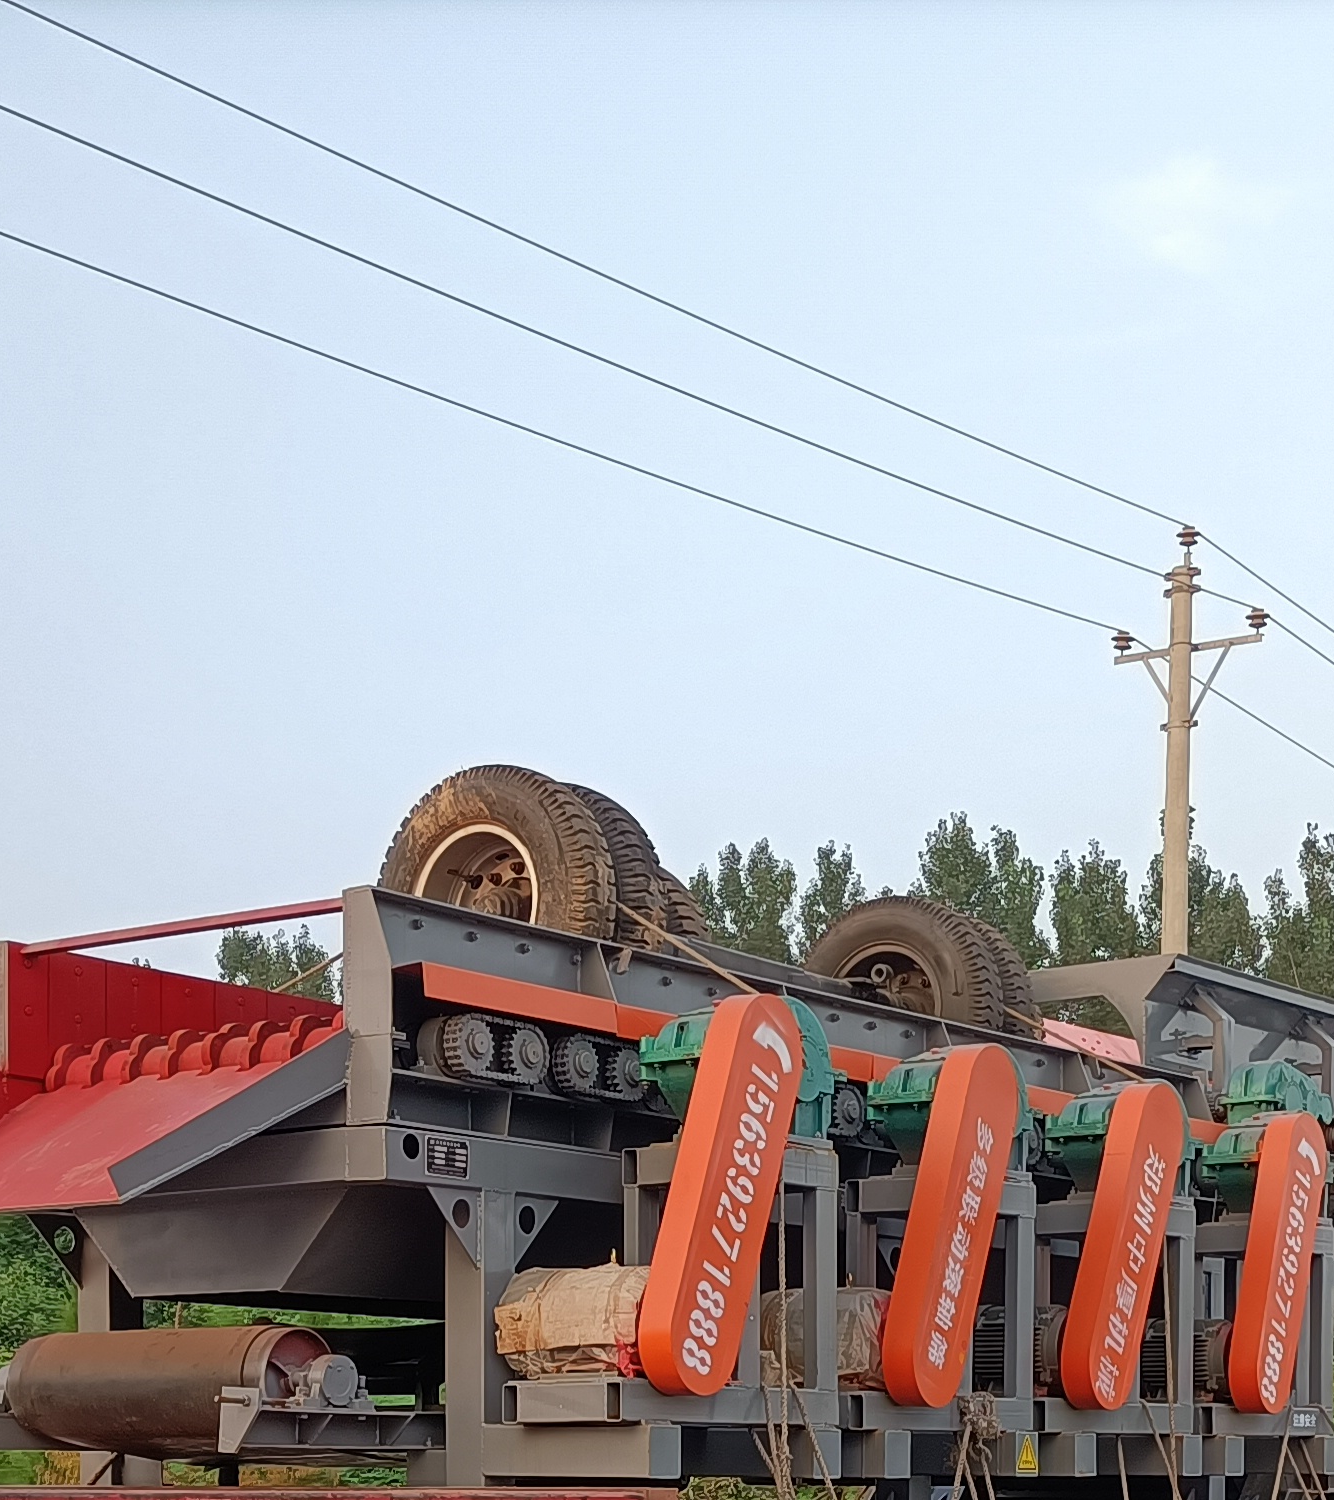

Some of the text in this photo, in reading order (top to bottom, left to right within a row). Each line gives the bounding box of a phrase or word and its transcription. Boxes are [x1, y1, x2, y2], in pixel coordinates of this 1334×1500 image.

[682, 1062, 779, 1376] 15639271888
[927, 1116, 994, 1371] 多级联动滚轴筛
[1094, 1143, 1166, 1402] 郑州中厚机械
[1260, 1169, 1313, 1405] 15639271888
